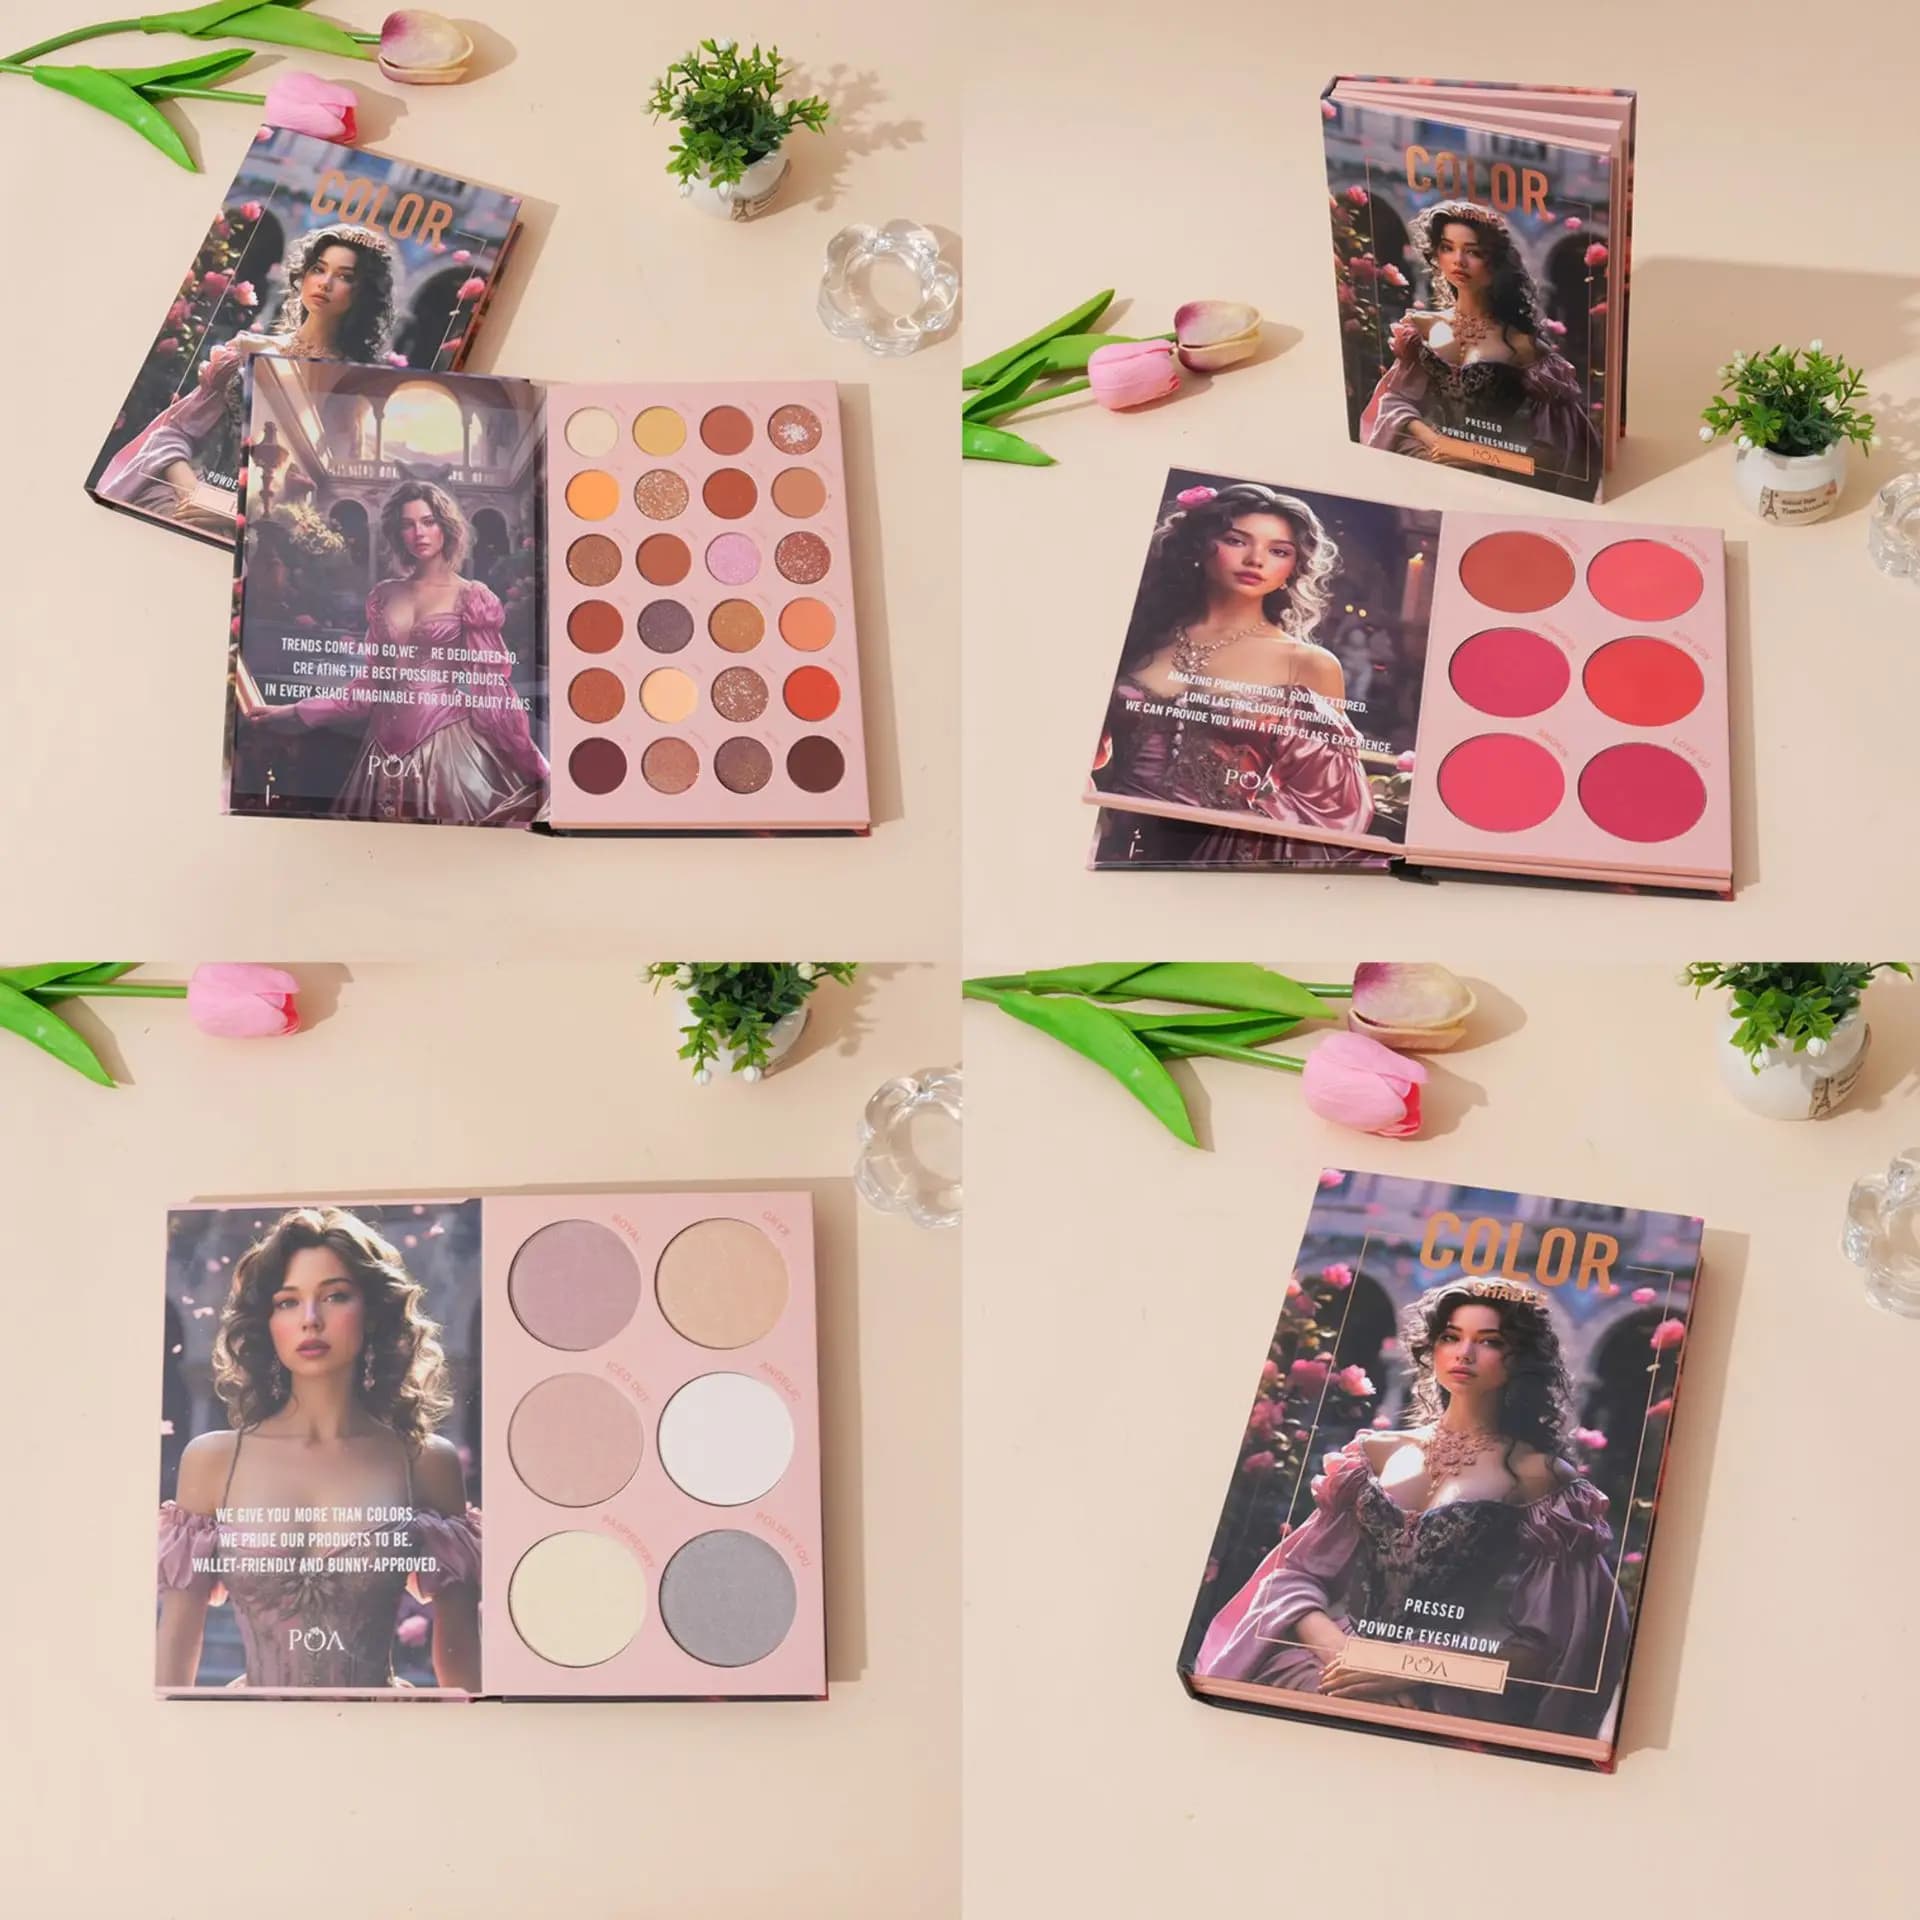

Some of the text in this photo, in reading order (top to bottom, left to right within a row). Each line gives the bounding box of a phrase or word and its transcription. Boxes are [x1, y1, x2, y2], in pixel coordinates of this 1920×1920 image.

[1405, 145, 1549, 223] COLOR
[311, 168, 453, 249] COLOR
[1465, 417, 1503, 433] PRESSED
[1442, 426, 1528, 453] POWDER EYESHADOW
[207, 471, 240, 490] POWDE
[281, 637, 322, 653] TRENDS
[325, 640, 354, 654] COME
[358, 642, 379, 656] AND
[431, 647, 444, 660] RE
[447, 648, 501, 664] DEDICATED
[293, 661, 314, 675] CRE
[316, 663, 347, 677] ATING
[350, 664, 369, 679] THE
[372, 666, 397, 681] BEST
[400, 668, 449, 683] POSSIBLE
[265, 683, 533, 711] IN EVERY SHADE IMAGINABLE FOR OUR BEAUTY FANS.
[1167, 670, 1212, 688] AMAZING
[1214, 677, 1287, 701] PIGMENTATION,
[1125, 700, 1141, 712] WE
[1143, 702, 1164, 715] CAN
[1165, 706, 1208, 723] PROVIDE
[1210, 713, 1230, 726] YOU
[1231, 716, 1256, 731] WITH
[1258, 721, 1266, 732] A
[1184, 691, 1209, 706] LONG
[1212, 695, 1253, 712] LASTING
[1255, 702, 1292, 718] LUXURY
[368, 754, 422, 778] POA
[1223, 768, 1279, 793] POA
[1419, 1211, 1619, 1294] COLOR
[215, 1506, 416, 1523] WE GIVE YOU MORE THAN COLORS.
[219, 1532, 412, 1548] WE PRIDE OUR PRODUCTS TO BE.
[192, 1557, 440, 1573] WALLET-FRIENDLY AND BUNNY-APPROVED.
[1404, 1598, 1465, 1620] PRESSED
[288, 1627, 345, 1652] POA
[1357, 1619, 1500, 1654] POWDER EYESHADOW
[1401, 1654, 1448, 1678] POA
